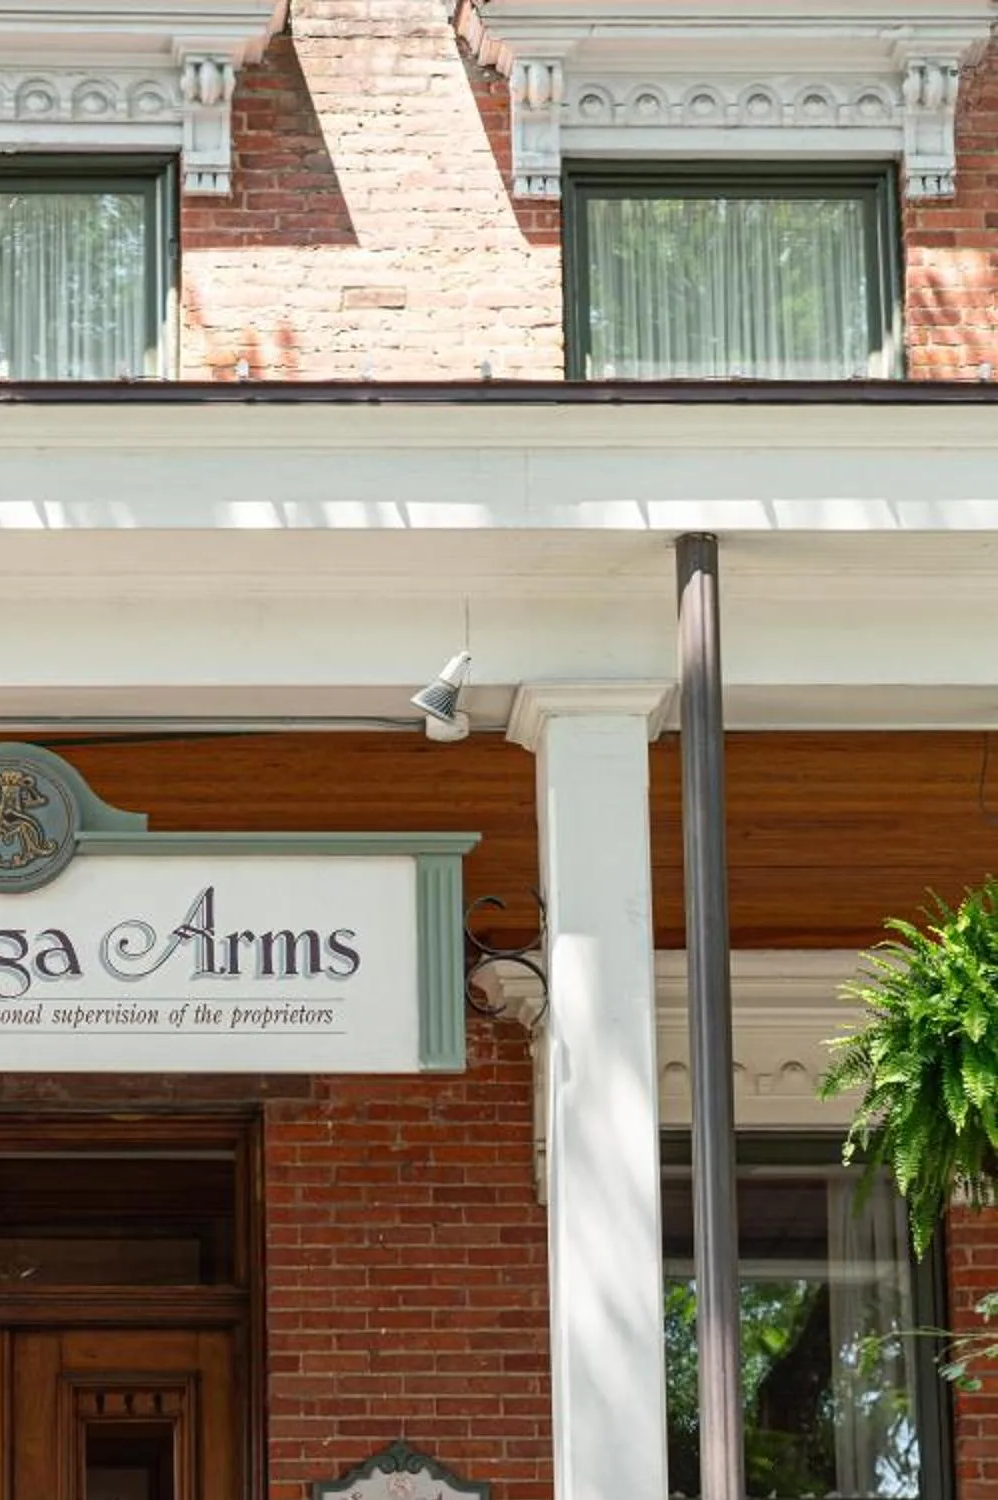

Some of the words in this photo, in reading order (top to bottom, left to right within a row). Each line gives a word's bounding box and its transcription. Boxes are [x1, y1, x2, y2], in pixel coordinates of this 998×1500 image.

[102, 886, 361, 979] Arms
[51, 1003, 159, 1028] supervision
[168, 1003, 191, 1028] of
[194, 1003, 222, 1024] the
[231, 1003, 334, 1029] proprietors
